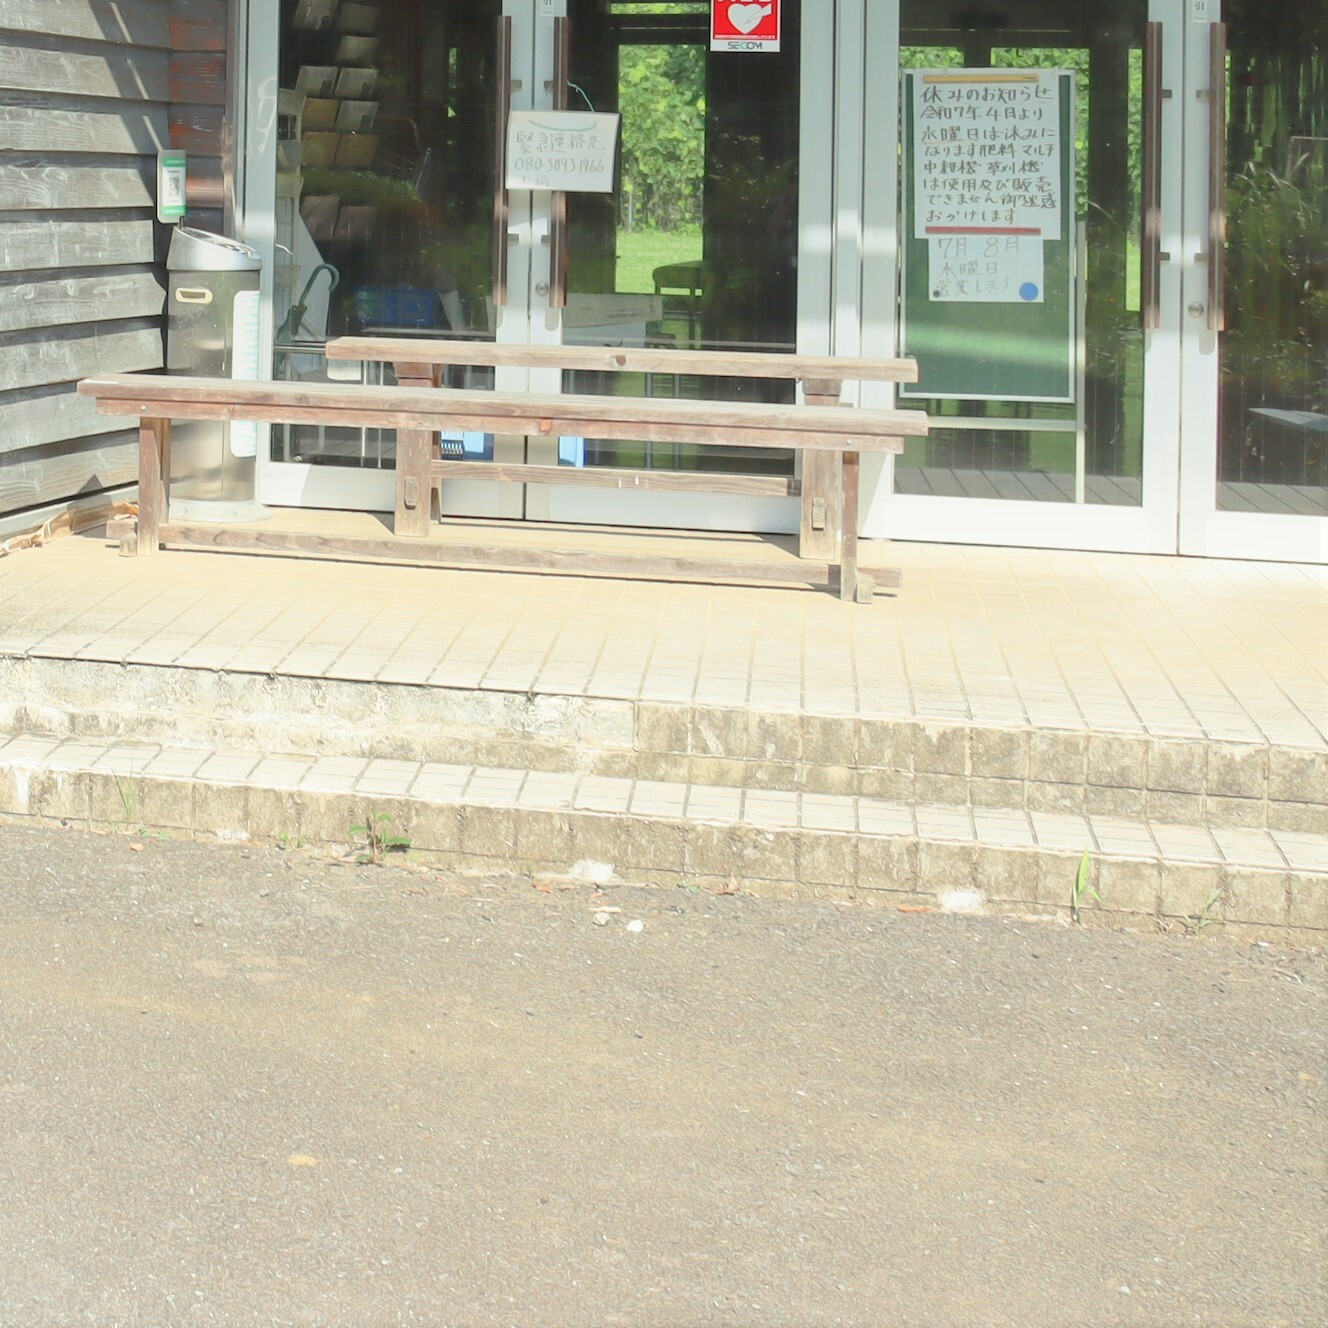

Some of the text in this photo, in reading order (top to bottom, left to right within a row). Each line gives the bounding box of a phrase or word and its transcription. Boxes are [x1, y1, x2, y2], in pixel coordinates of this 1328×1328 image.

[728, 41, 763, 50] SECOM
[921, 84, 1056, 104] 休みのお知らせ
[921, 125, 1056, 141] 水曜日は休みに
[516, 130, 606, 154] 緊急連絡先
[923, 176, 1052, 193] は使用及び販売
[926, 208, 1016, 225] おかけします
[938, 236, 1020, 259] 7月 8月
[940, 261, 997, 276] 水曜日
